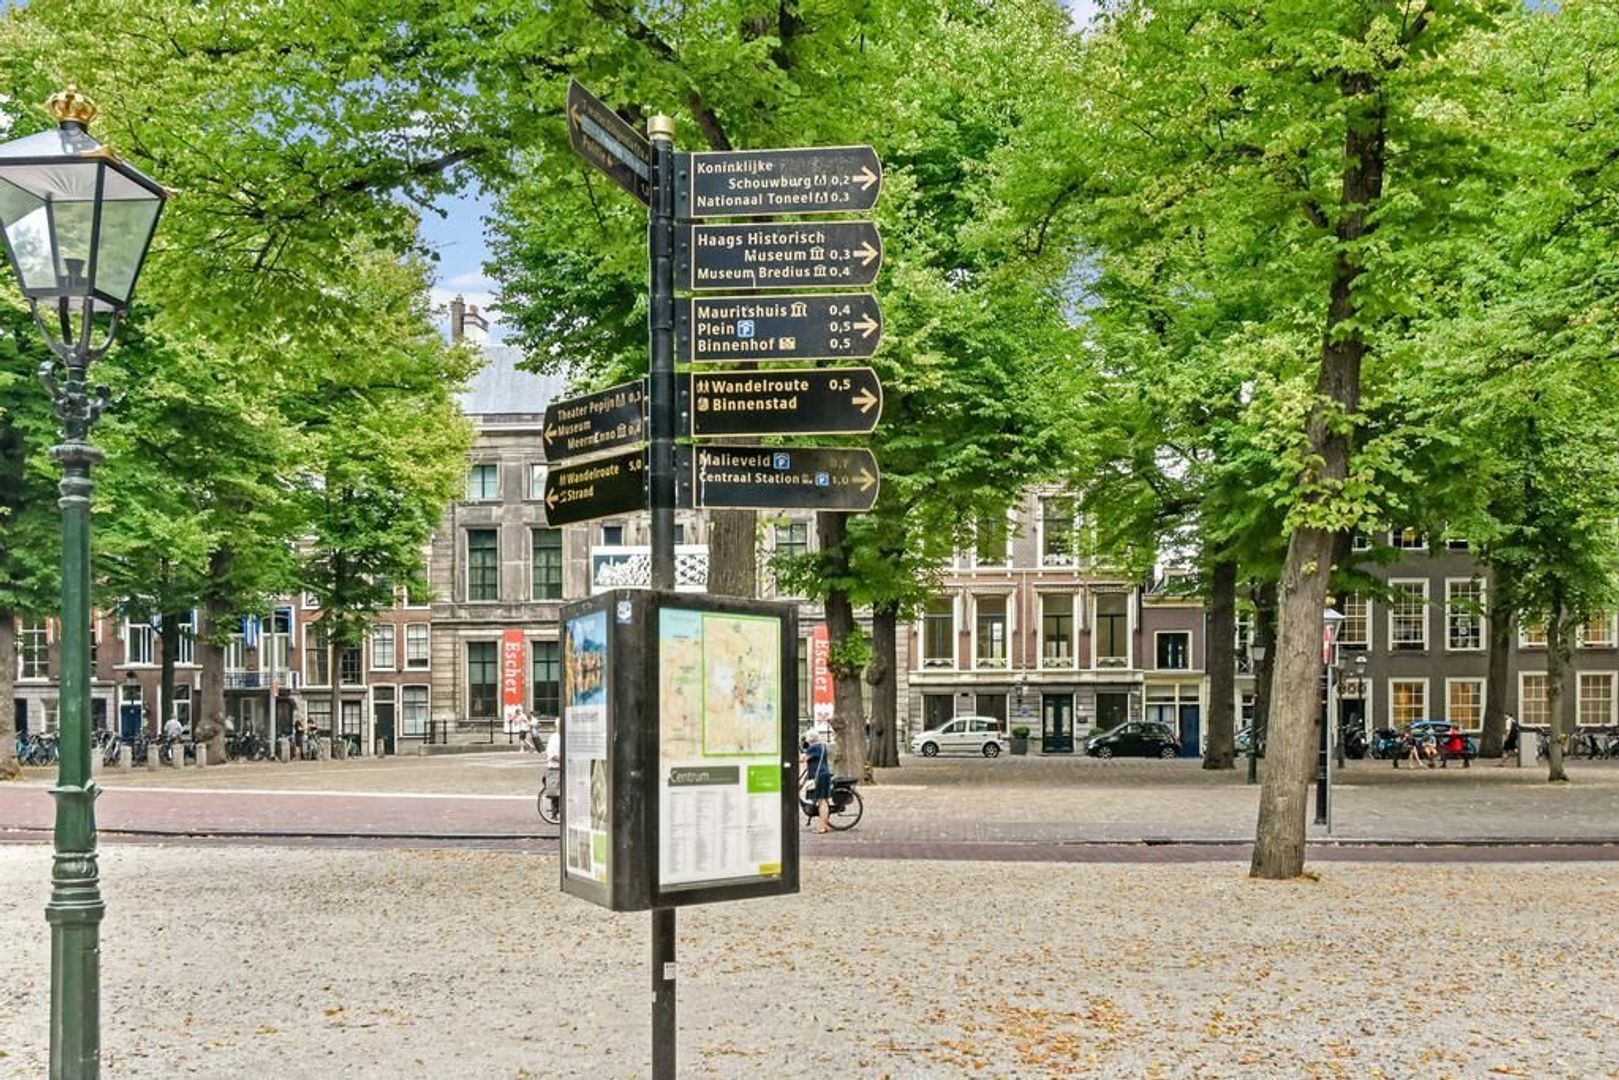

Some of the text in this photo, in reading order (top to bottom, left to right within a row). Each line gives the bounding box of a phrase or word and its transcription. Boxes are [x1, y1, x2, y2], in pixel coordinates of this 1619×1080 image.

[697, 160, 773, 174] Koninklijke
[728, 175, 850, 190] Schouwburg 0,2
[697, 194, 762, 207] Nationaal
[768, 192, 813, 204] Toneel
[697, 231, 825, 249] Haags Historisch
[744, 249, 850, 262] Museum 0,3
[697, 267, 754, 279] Museum
[759, 266, 811, 278] Bredius
[697, 303, 787, 319] Mauritshuis
[697, 321, 850, 336] Plein 0,5
[697, 337, 775, 352] Binnenhof
[713, 379, 850, 393] Wandelroute 0,5
[713, 396, 797, 411] Binnenstad
[558, 420, 591, 436] Museum
[699, 453, 771, 467] Malieveld
[567, 464, 619, 483] Wandelroute
[699, 471, 751, 483] Centraal
[755, 472, 800, 484] Station
[567, 485, 594, 500] Strand
[505, 642, 521, 694] Escher
[671, 770, 710, 783] Centrum
